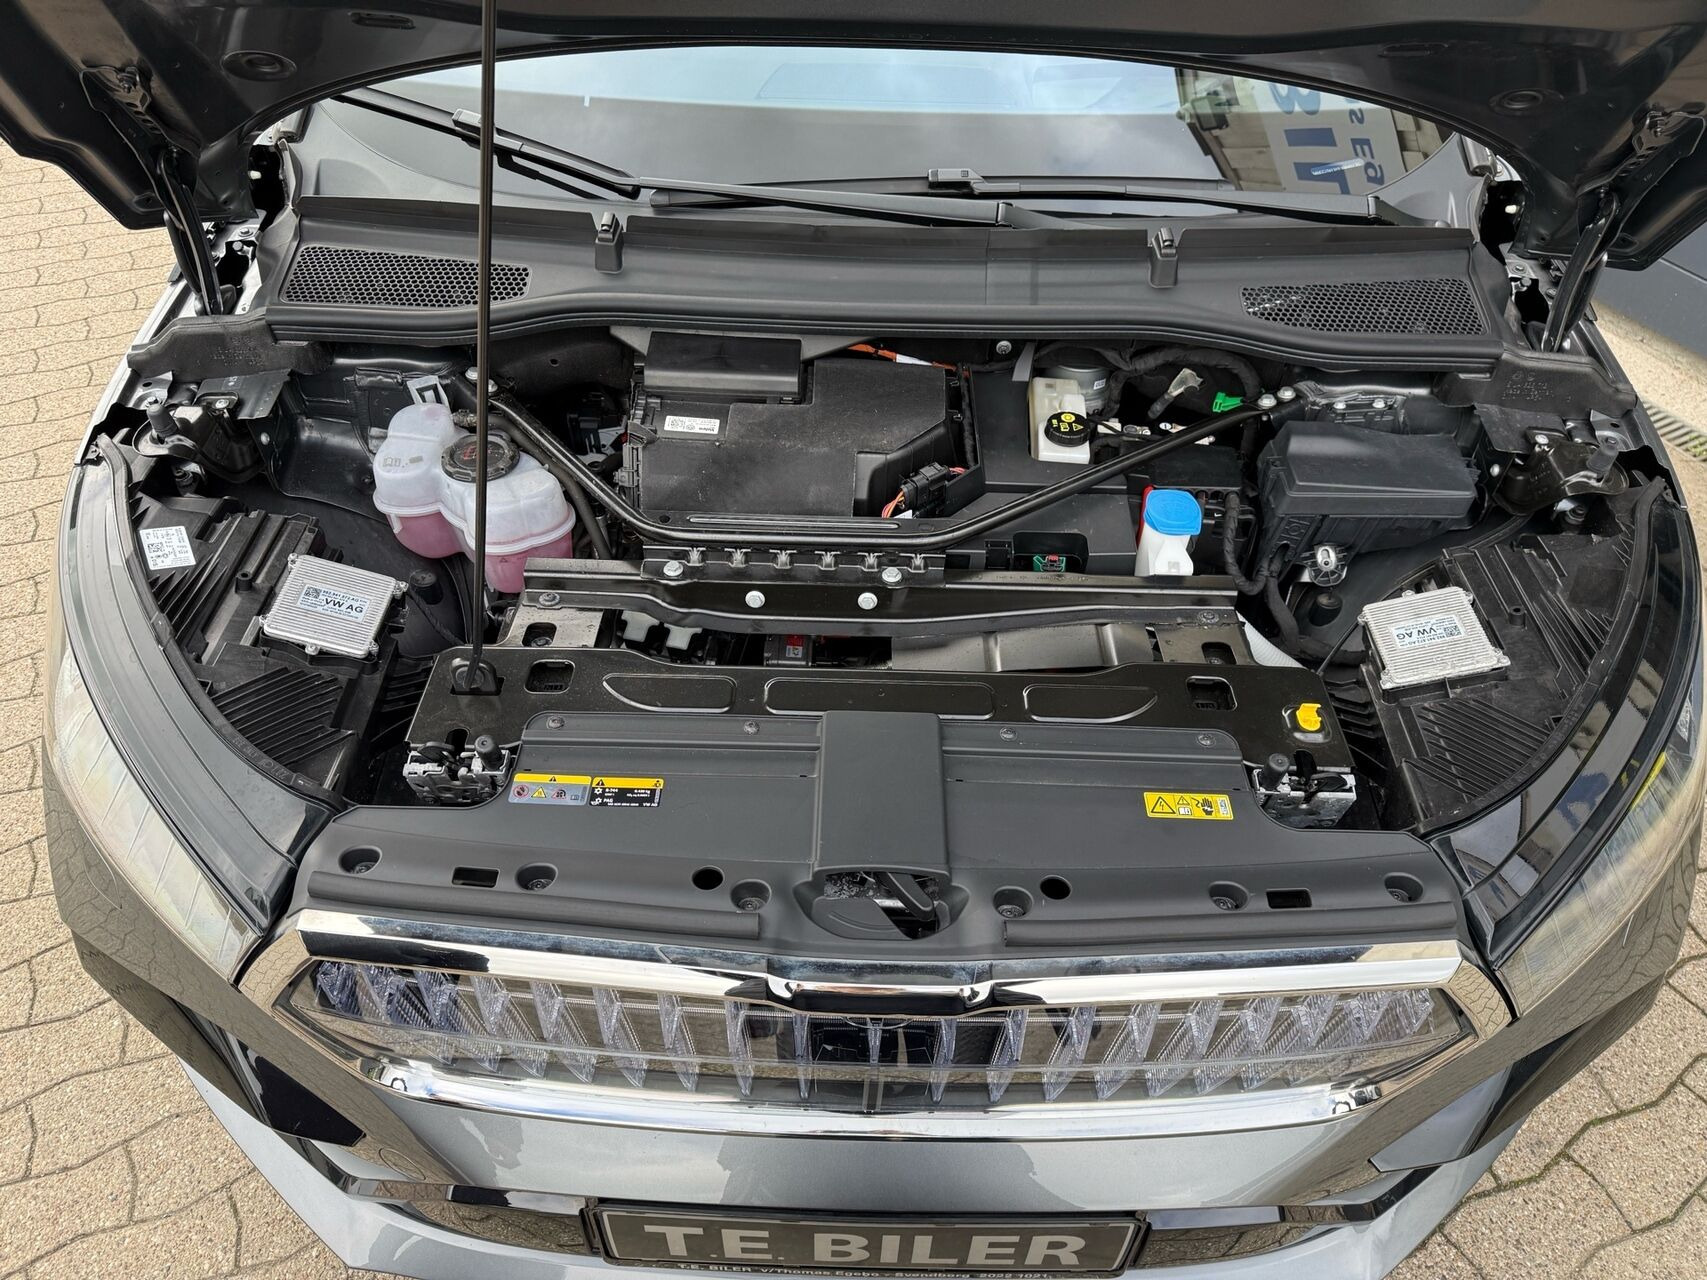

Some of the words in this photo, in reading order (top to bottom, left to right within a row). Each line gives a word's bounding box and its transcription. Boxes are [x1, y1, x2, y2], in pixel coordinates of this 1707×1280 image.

[324, 597, 345, 608] VW
[346, 604, 364, 614] AG
[1396, 631, 1413, 640] AG
[1417, 627, 1437, 637] VW
[644, 1224, 785, 1260] T.E.
[814, 1233, 1086, 1266] BILER
[709, 1264, 752, 1273] BILER
[835, 1270, 879, 1278] Egebo
